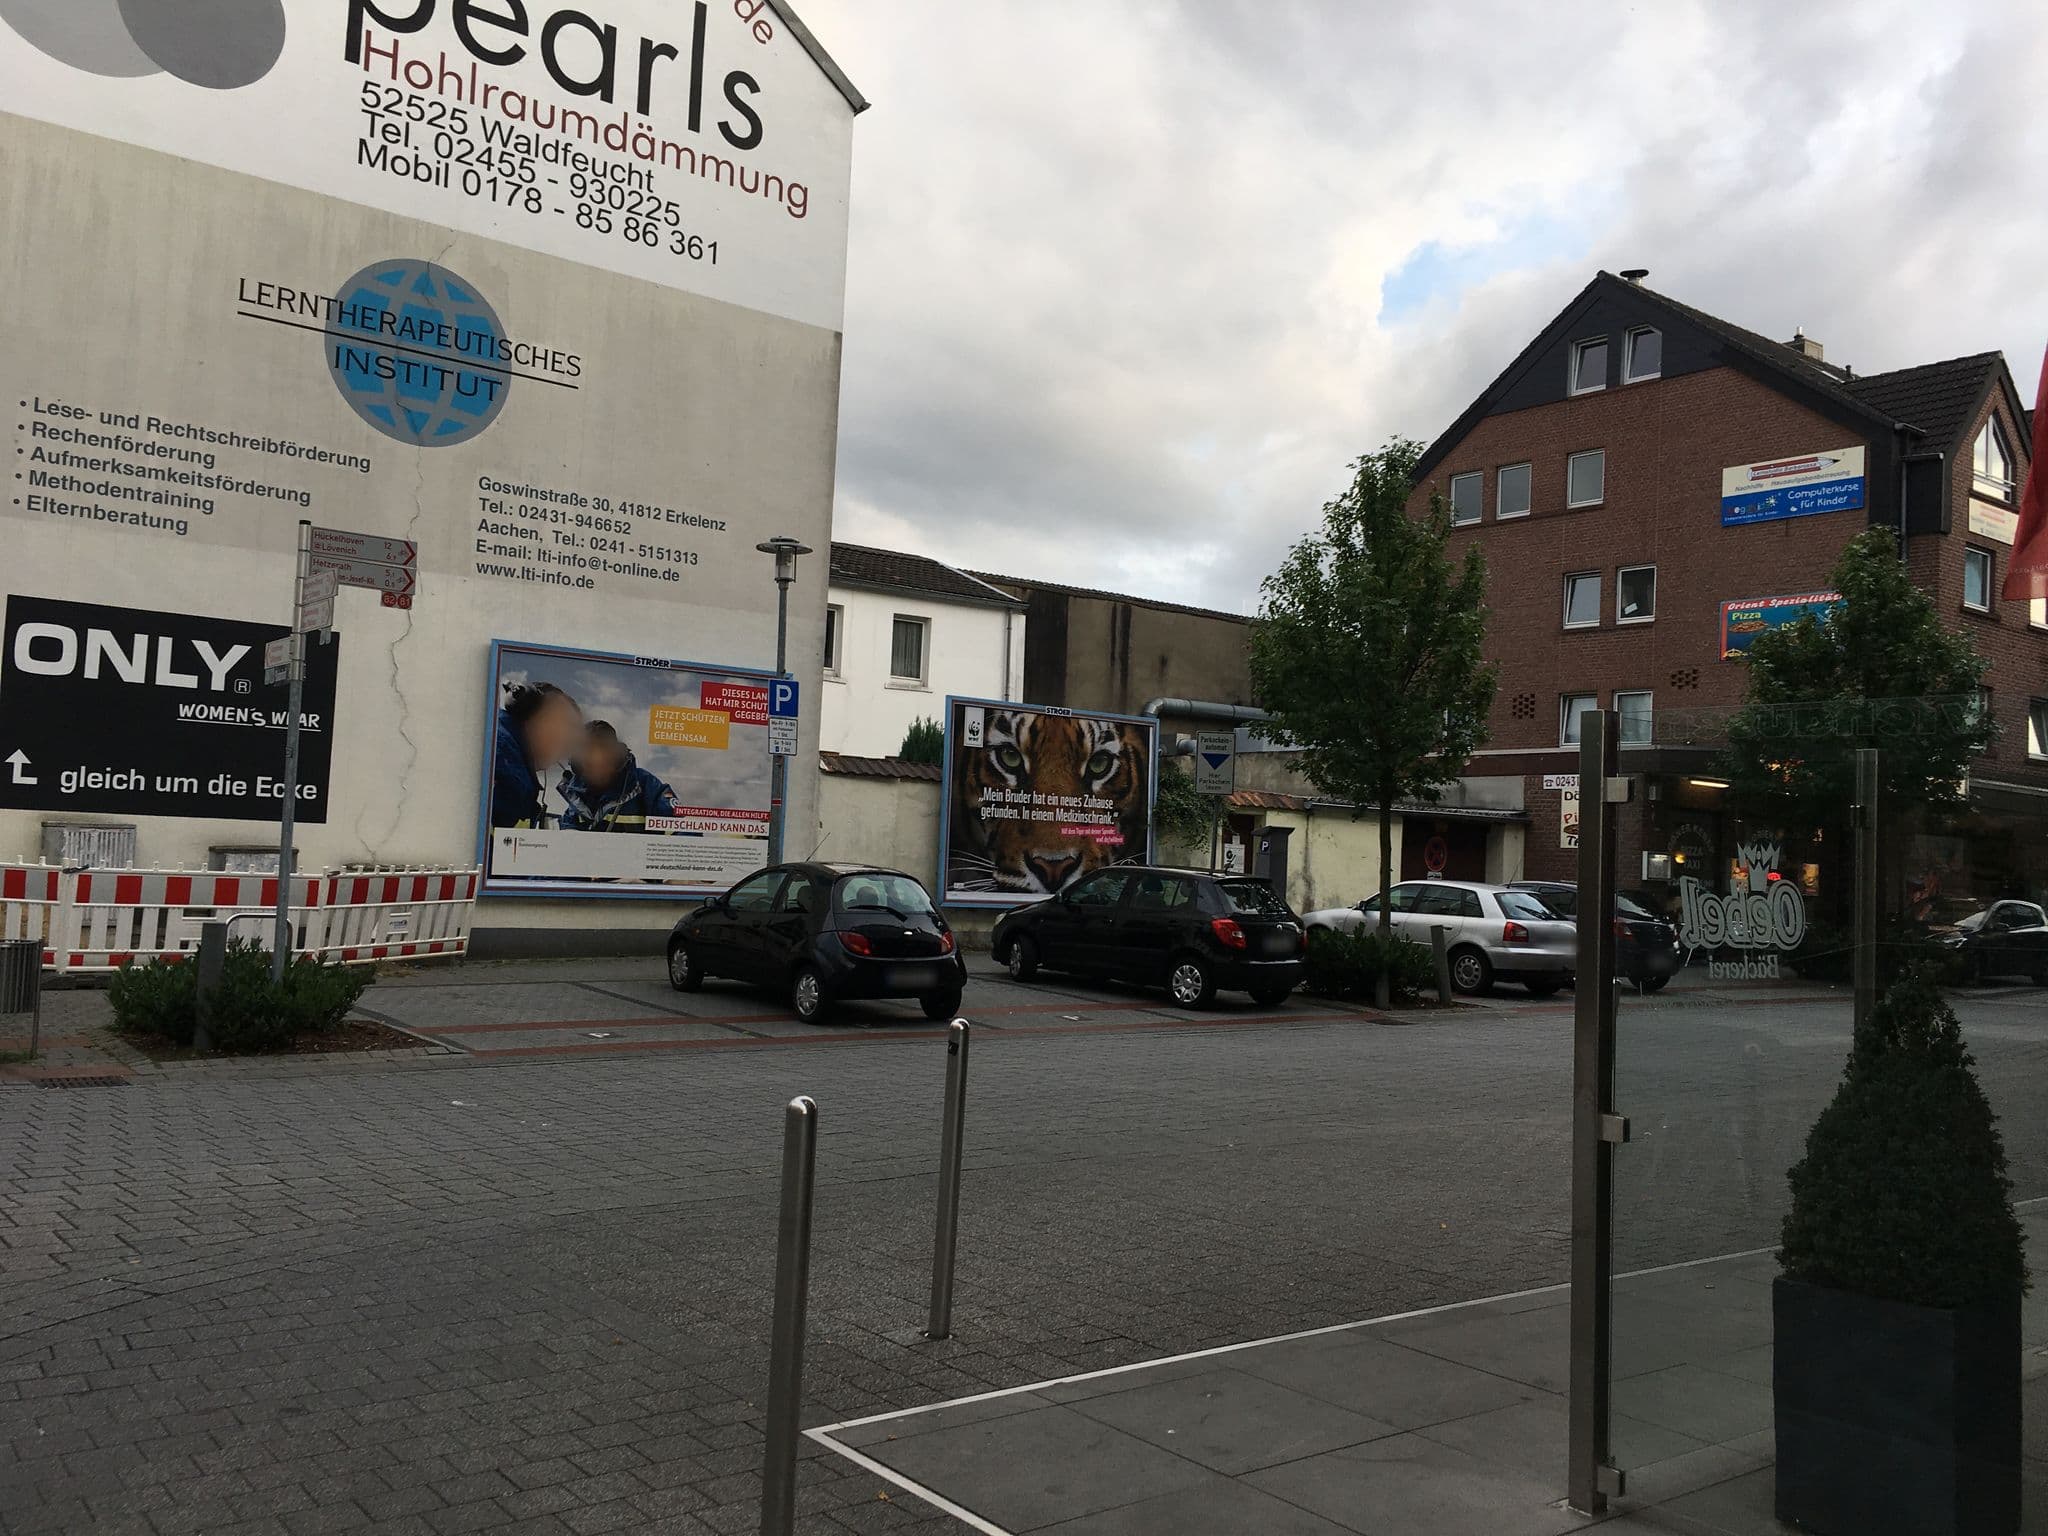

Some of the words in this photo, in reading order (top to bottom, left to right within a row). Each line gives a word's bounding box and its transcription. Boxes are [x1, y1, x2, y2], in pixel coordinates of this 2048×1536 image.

[344, 0, 764, 150] pearls
[361, 80, 469, 135] 52525
[480, 115, 655, 193] Waldfeucht
[362, 30, 809, 219] Hohlraumdämmung
[361, 108, 420, 151] Tel.
[434, 131, 536, 184] 02455
[569, 172, 681, 227] 930225
[357, 137, 450, 188] Mobil
[462, 168, 543, 215] 0178
[575, 202, 613, 234] 85
[623, 216, 659, 247] 86
[669, 229, 719, 265] 361
[237, 277, 582, 378] LERNTHERAPEUTISCHES
[333, 345, 503, 402] INSTITUT
[31, 420, 217, 469] Rechenförderung
[33, 396, 93, 421] Lese-
[99, 410, 139, 431] und
[146, 416, 372, 474] Rechtschreibförderung
[30, 445, 312, 507] Aufmerksamkeitsförderung
[28, 469, 216, 515] Methodentraining
[478, 475, 588, 509] Goswinstraße
[592, 497, 615, 518] 30,
[618, 501, 662, 521] 41812
[665, 508, 727, 532] Erkelenz
[1788, 483, 1860, 500] Computerkurse
[1800, 499, 1815, 509] für
[1817, 495, 1848, 507] Kinder
[26, 494, 190, 536] Elternberatung
[478, 497, 514, 517] Tel.:
[517, 503, 632, 536] 02431-946652
[475, 538, 532, 562] E-mail:
[477, 518, 544, 544] Aachen,
[552, 530, 585, 549] Tel.:
[589, 536, 625, 555] 0241
[638, 543, 699, 567] 5151313
[475, 561, 595, 590] www.lti-info.de
[1727, 600, 1765, 611] Orient
[1768, 592, 1843, 608] Spezialität
[1731, 611, 1762, 621] Pizza
[14, 622, 251, 691] ONLY
[705, 697, 721, 706] HAT
[723, 699, 740, 708] MIR
[741, 700, 769, 710] SCHUT
[721, 688, 750, 699] DIESES
[751, 692, 769, 701] LAN
[775, 684, 793, 712] P
[271, 710, 321, 729] WAR
[654, 721, 673, 730] WIR
[674, 722, 685, 731] ES
[655, 710, 681, 720] JETZT
[681, 711, 726, 724] SCHÜTZEN
[654, 731, 709, 743] GEMEINSAM.
[60, 766, 146, 794] gleich
[155, 775, 198, 794] um
[207, 773, 248, 796] die
[675, 808, 720, 818] INTEGRATION,
[980, 803, 1021, 820] gefunden.
[1022, 806, 1030, 820] In
[1031, 808, 1054, 821] einem
[1004, 789, 1032, 804] Bruder
[1032, 790, 1046, 804] hat
[1047, 793, 1059, 805] ein
[1060, 795, 1082, 807] neues
[1083, 795, 1114, 809] Zuhause
[648, 819, 718, 831] DEUTSCHLAND
[720, 823, 746, 833] KANN
[748, 824, 768, 834] DAS.
[1261, 840, 1269, 851] P
